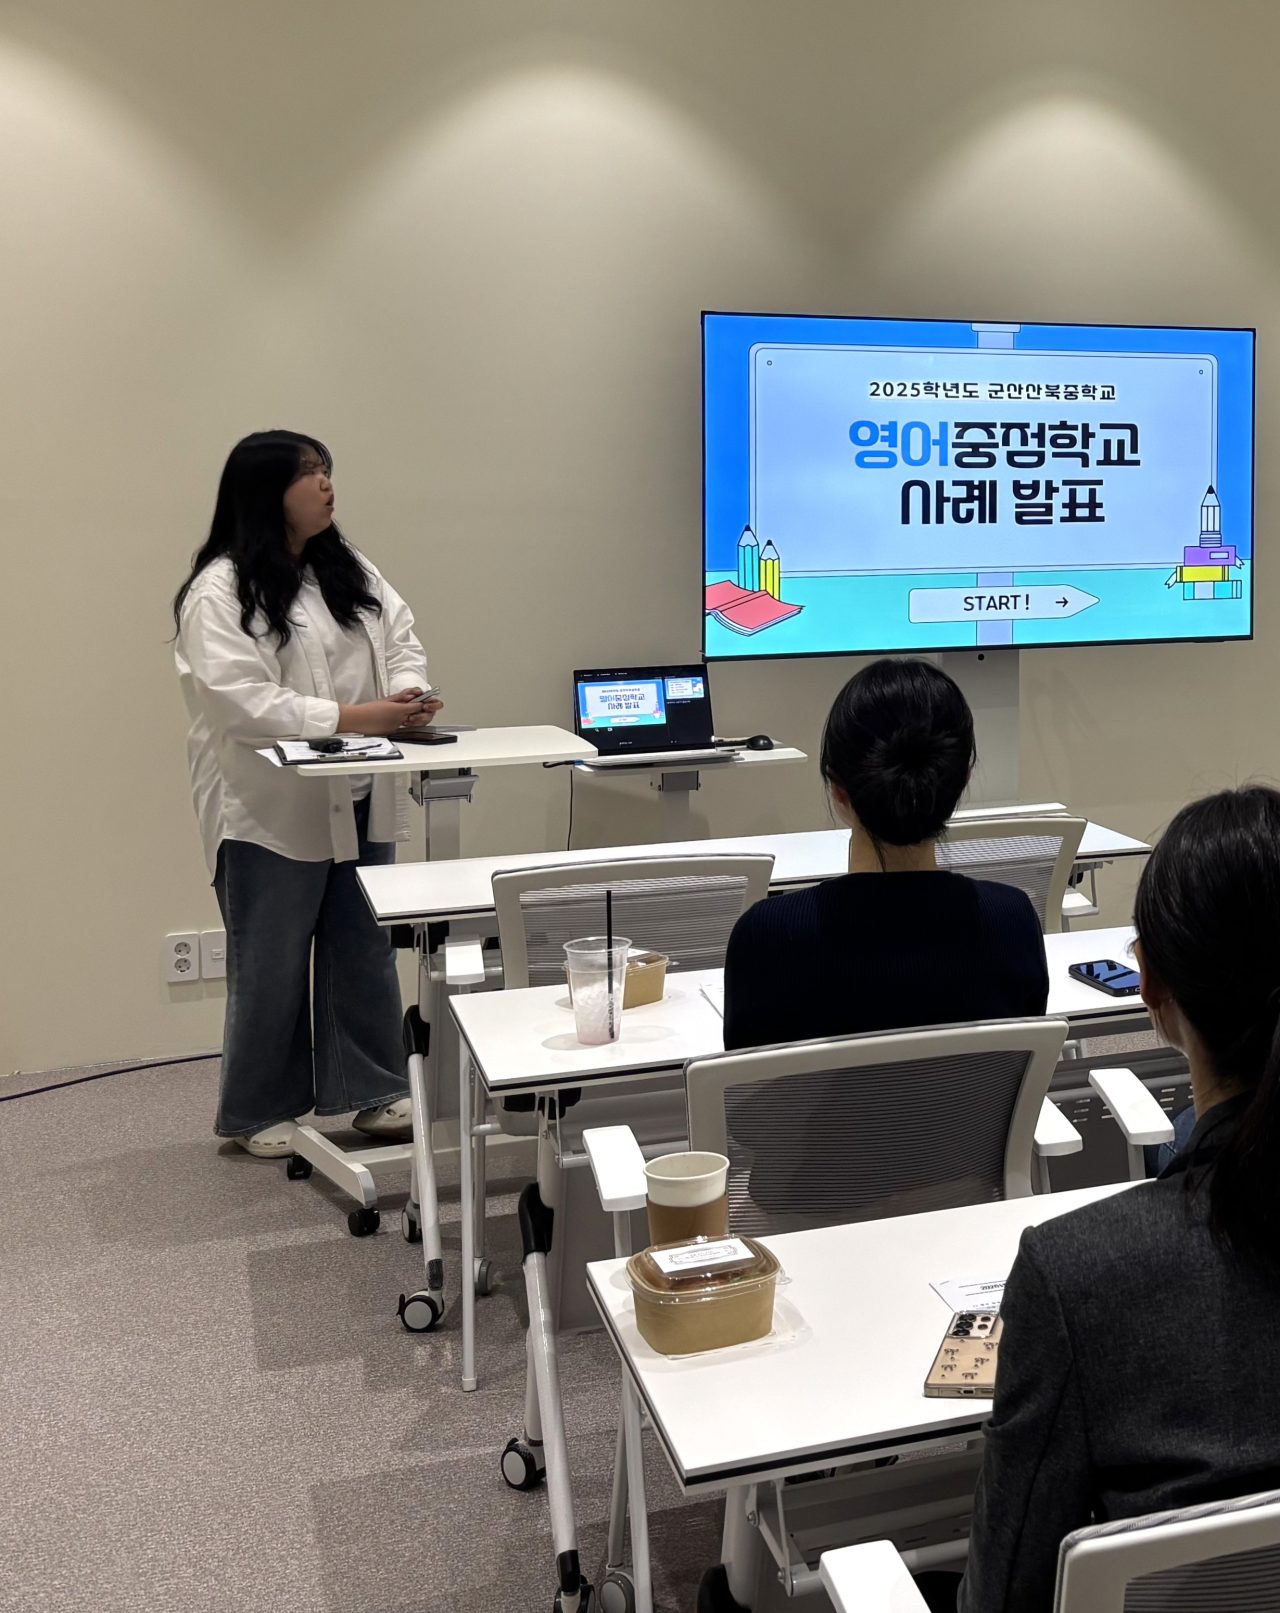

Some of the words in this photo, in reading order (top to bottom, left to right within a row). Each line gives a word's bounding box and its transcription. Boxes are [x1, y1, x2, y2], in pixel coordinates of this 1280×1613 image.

[869, 381, 980, 399] 2025학년도
[987, 382, 1116, 401] 군산산북중학교
[848, 420, 1141, 469] 영어중점학교
[901, 479, 998, 525] 사례
[1012, 479, 1105, 525] 발표
[963, 593, 1030, 611] START!
